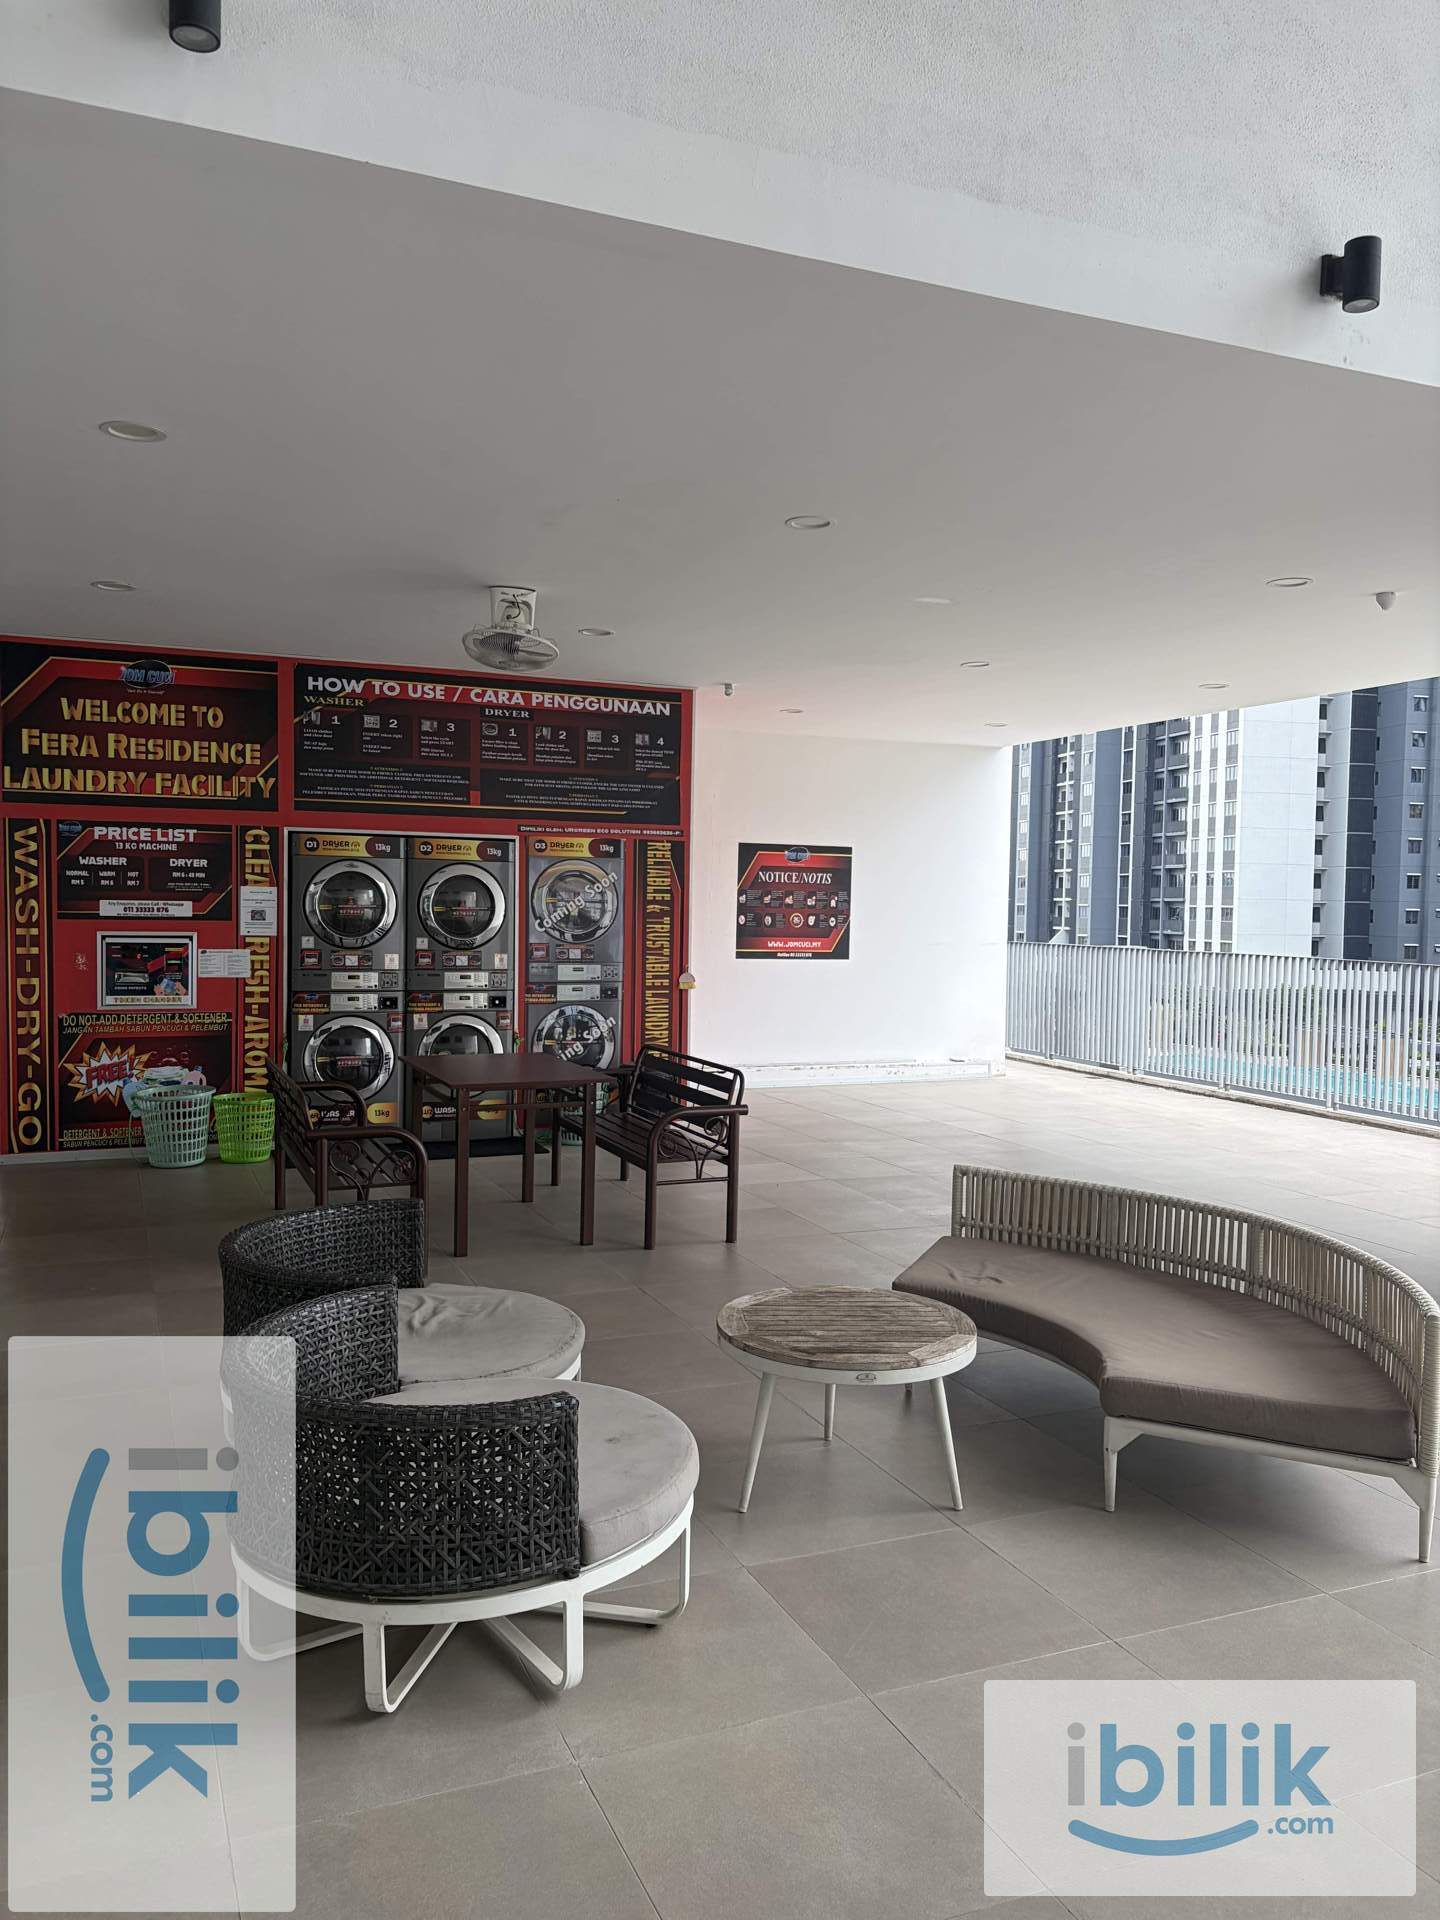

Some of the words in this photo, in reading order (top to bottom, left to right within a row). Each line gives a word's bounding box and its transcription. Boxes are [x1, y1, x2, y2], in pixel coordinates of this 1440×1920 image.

[304, 695, 365, 708] WASHER
[307, 676, 365, 694] HOW
[371, 680, 400, 697] TO
[407, 683, 446, 700] USE
[470, 688, 525, 706] CARA
[531, 693, 671, 717] PENGGUNAAN
[60, 697, 185, 727] WELCOME
[192, 705, 224, 729] TO
[485, 707, 531, 719] DRYER
[331, 715, 341, 725] 1
[388, 718, 399, 729] 2
[446, 722, 455, 732] 3
[509, 728, 517, 737] 1
[558, 730, 567, 740] 2
[611, 734, 620, 744] 3
[21, 728, 100, 758] FERA
[107, 733, 261, 765] RESIDENCE
[656, 736, 665, 746] 4
[3, 766, 148, 794] LAUNDRY
[155, 772, 276, 799] FACILITY
[94, 826, 152, 841] PRICE
[157, 828, 198, 842] LIST
[115, 842, 123, 850] 13
[125, 842, 137, 850] KG
[138, 843, 178, 851] MACHINE
[322, 840, 350, 848] DRYER
[420, 844, 433, 852] D2
[436, 843, 463, 852] DRYER
[549, 841, 575, 849] DRYER
[486, 847, 502, 856] 13kg
[79, 855, 128, 866] WASHER
[169, 858, 208, 868] DRYER
[645, 841, 672, 901] RELIABLE
[758, 871, 833, 884] NOTICE/NOTIS
[534, 895, 586, 933] Coming
[585, 871, 619, 899] Soon
[13, 825, 42, 1146] WASH-DRY-GO
[64, 1014, 77, 1026] DO
[79, 1014, 97, 1026] NOT
[100, 1014, 118, 1025] ADD
[120, 1013, 173, 1025] DETERGENT
[182, 1012, 228, 1024] SOFTENER
[644, 990, 670, 1047] LAUNDRY
[126, 1025, 151, 1033] SABUN
[582, 1017, 617, 1043] Soon
[63, 1128, 100, 1139] DETERGENT
